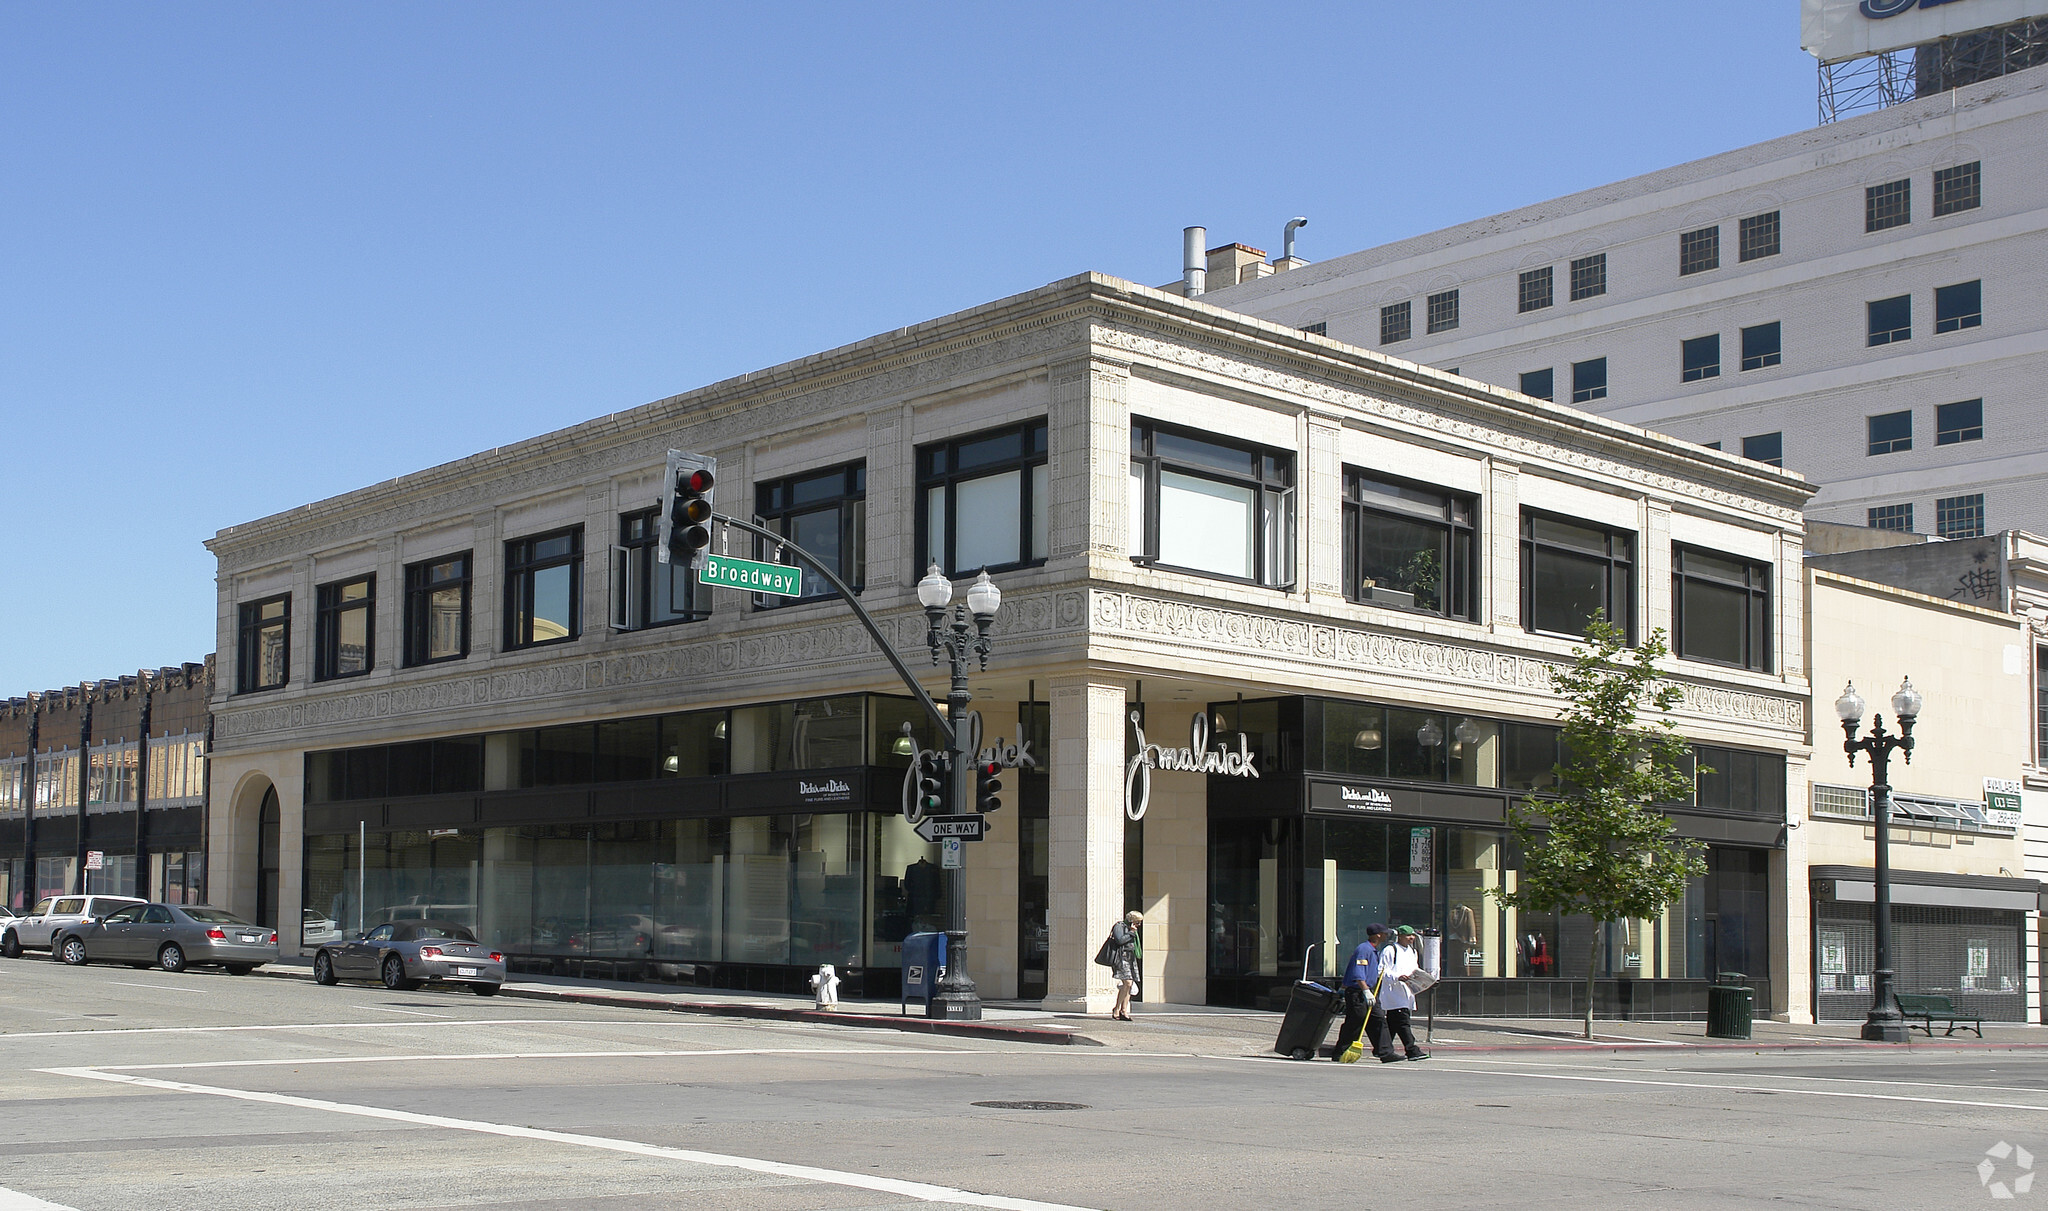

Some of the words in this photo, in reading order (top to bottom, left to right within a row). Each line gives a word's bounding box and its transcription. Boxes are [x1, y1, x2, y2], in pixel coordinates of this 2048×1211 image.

[708, 561, 793, 593] Broadway
[1987, 779, 2021, 794] AVAILABLE
[933, 823, 952, 834] ONE
[955, 822, 976, 834] WAY
